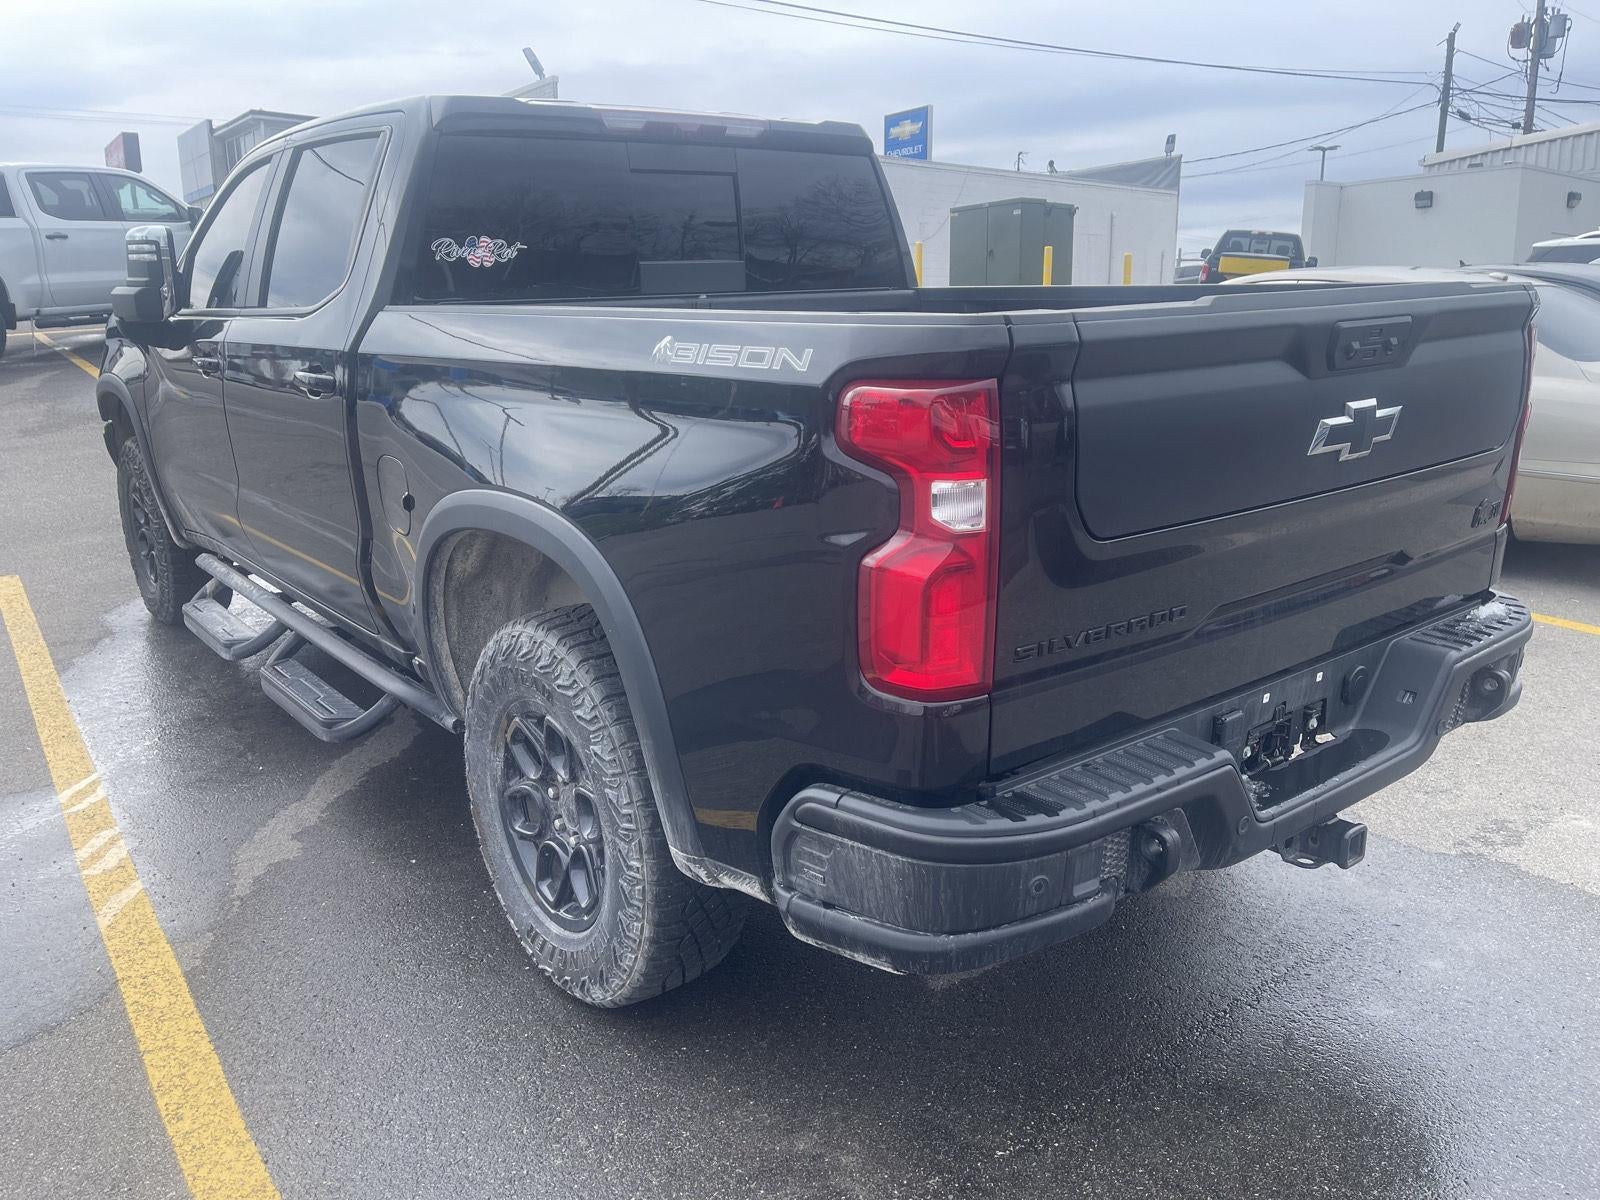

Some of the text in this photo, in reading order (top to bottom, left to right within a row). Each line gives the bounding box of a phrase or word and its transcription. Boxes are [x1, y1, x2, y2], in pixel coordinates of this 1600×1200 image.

[886, 144, 922, 157] CHEVROLET
[487, 238, 527, 262] Rat
[670, 342, 814, 372] BISON
[1012, 603, 1188, 663] SILVERADO
